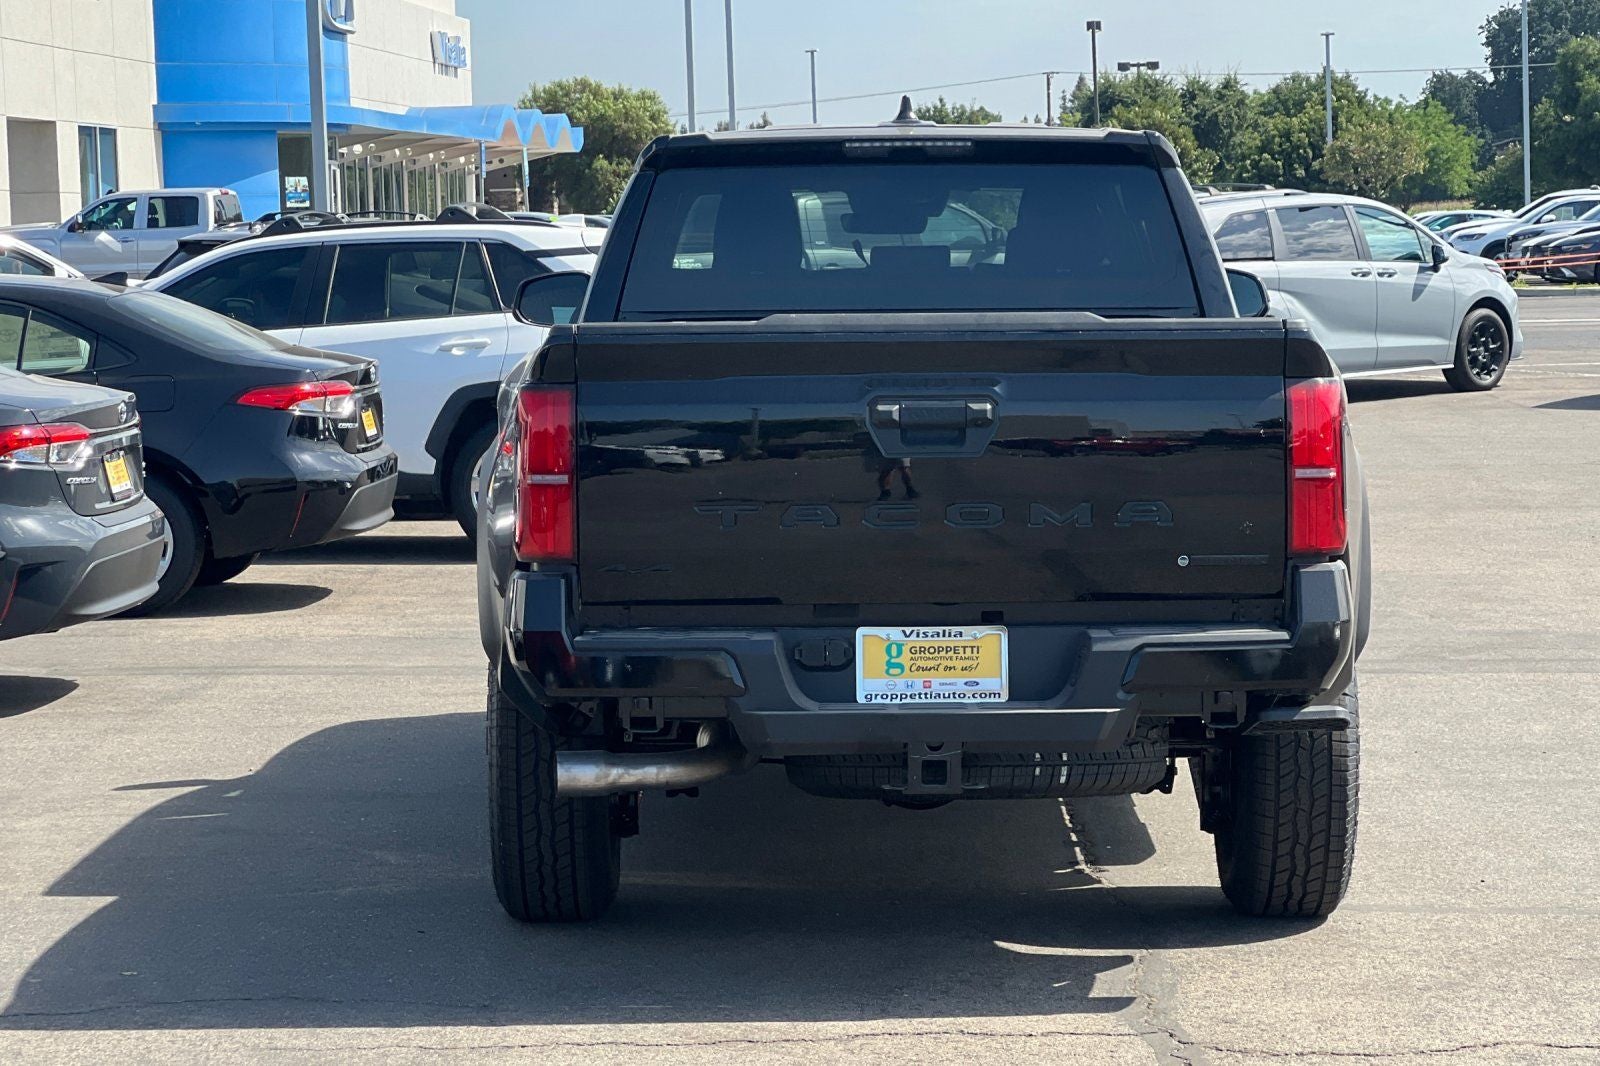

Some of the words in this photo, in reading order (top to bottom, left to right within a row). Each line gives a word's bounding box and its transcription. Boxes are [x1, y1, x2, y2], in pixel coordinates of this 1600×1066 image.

[693, 500, 1175, 530] TACOMA
[901, 629, 963, 638] Visalia
[909, 645, 980, 655] GROPPETTI
[909, 662, 940, 673] Count
[864, 690, 1002, 702] groppettiauto.com
